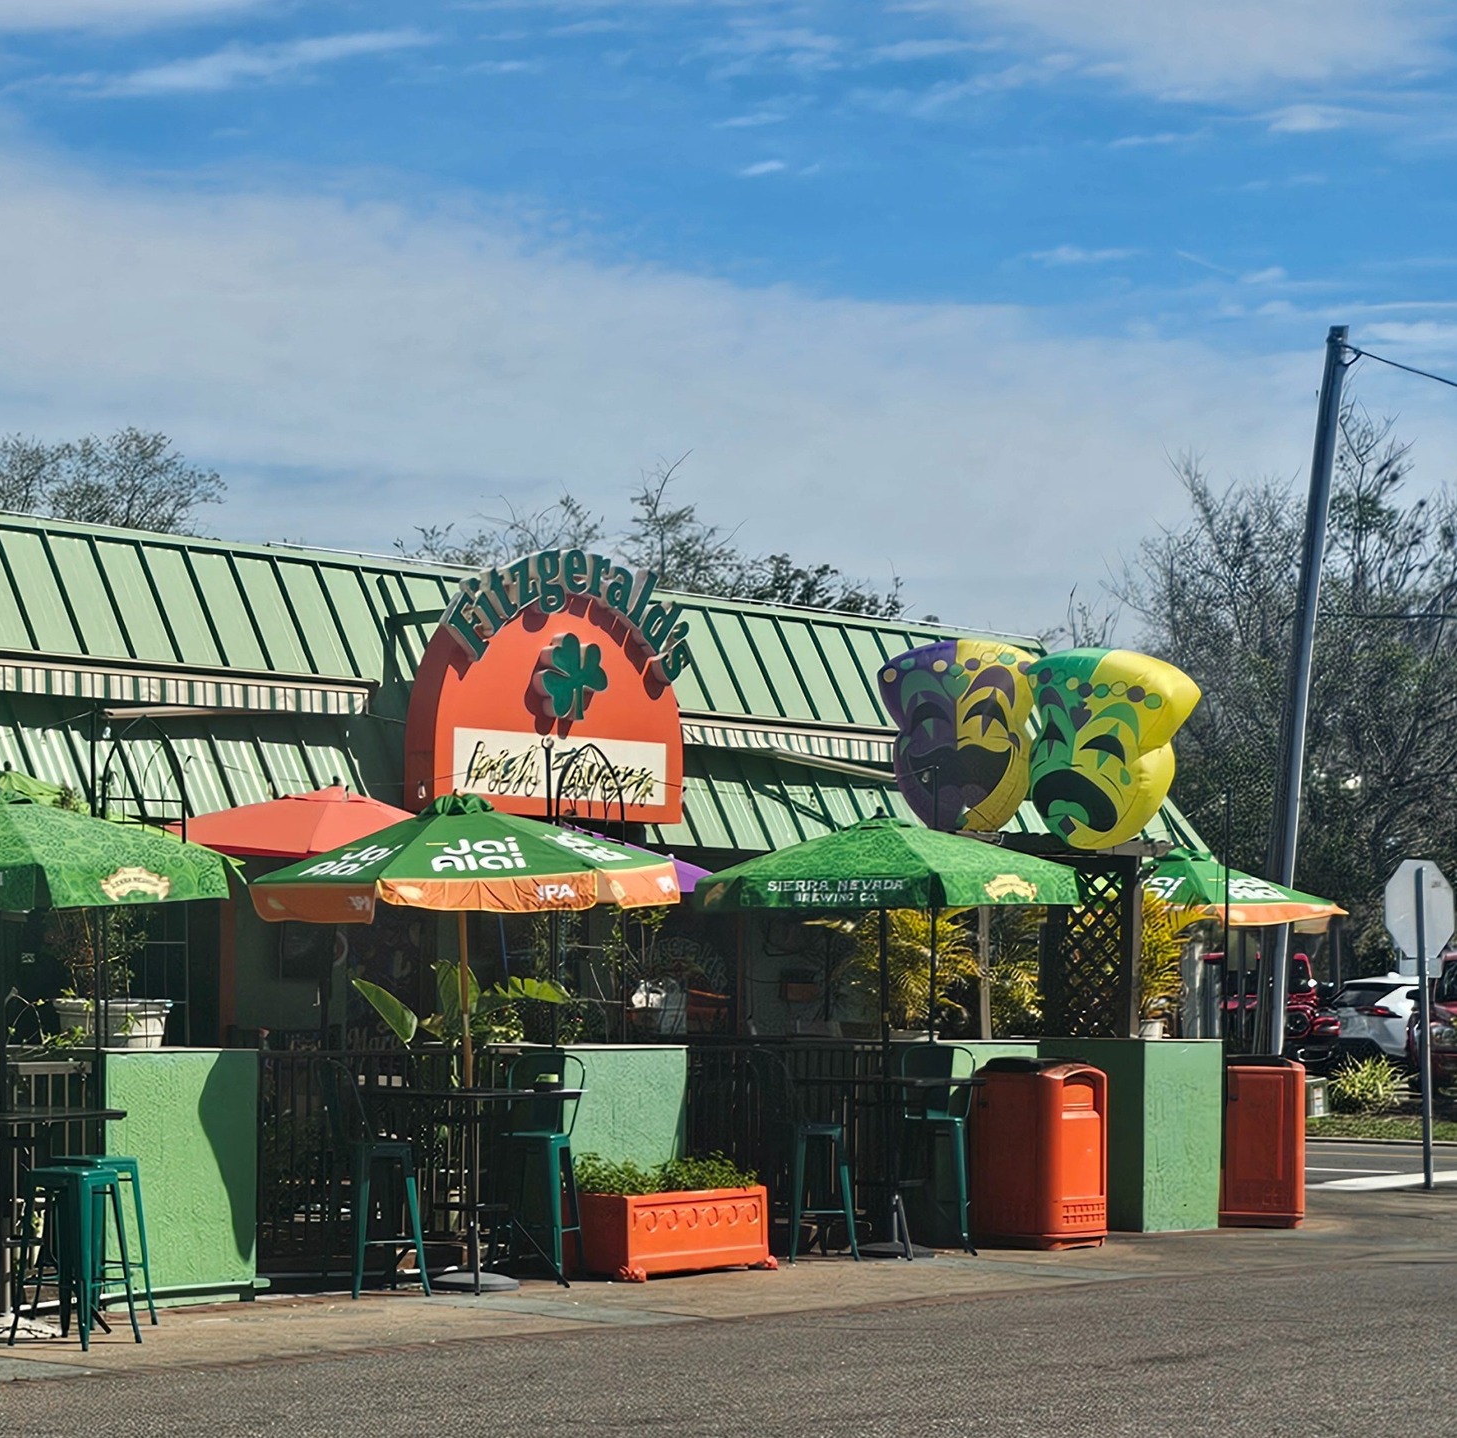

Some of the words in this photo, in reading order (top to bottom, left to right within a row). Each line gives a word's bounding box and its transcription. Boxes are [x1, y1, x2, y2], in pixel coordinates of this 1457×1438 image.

[439, 549, 692, 684] Fitzgerald's
[442, 836, 520, 855] Jai
[430, 854, 527, 872] Alai
[537, 884, 575, 901] IPA
[767, 880, 830, 892] SIERRA
[837, 879, 904, 892] NEVADA
